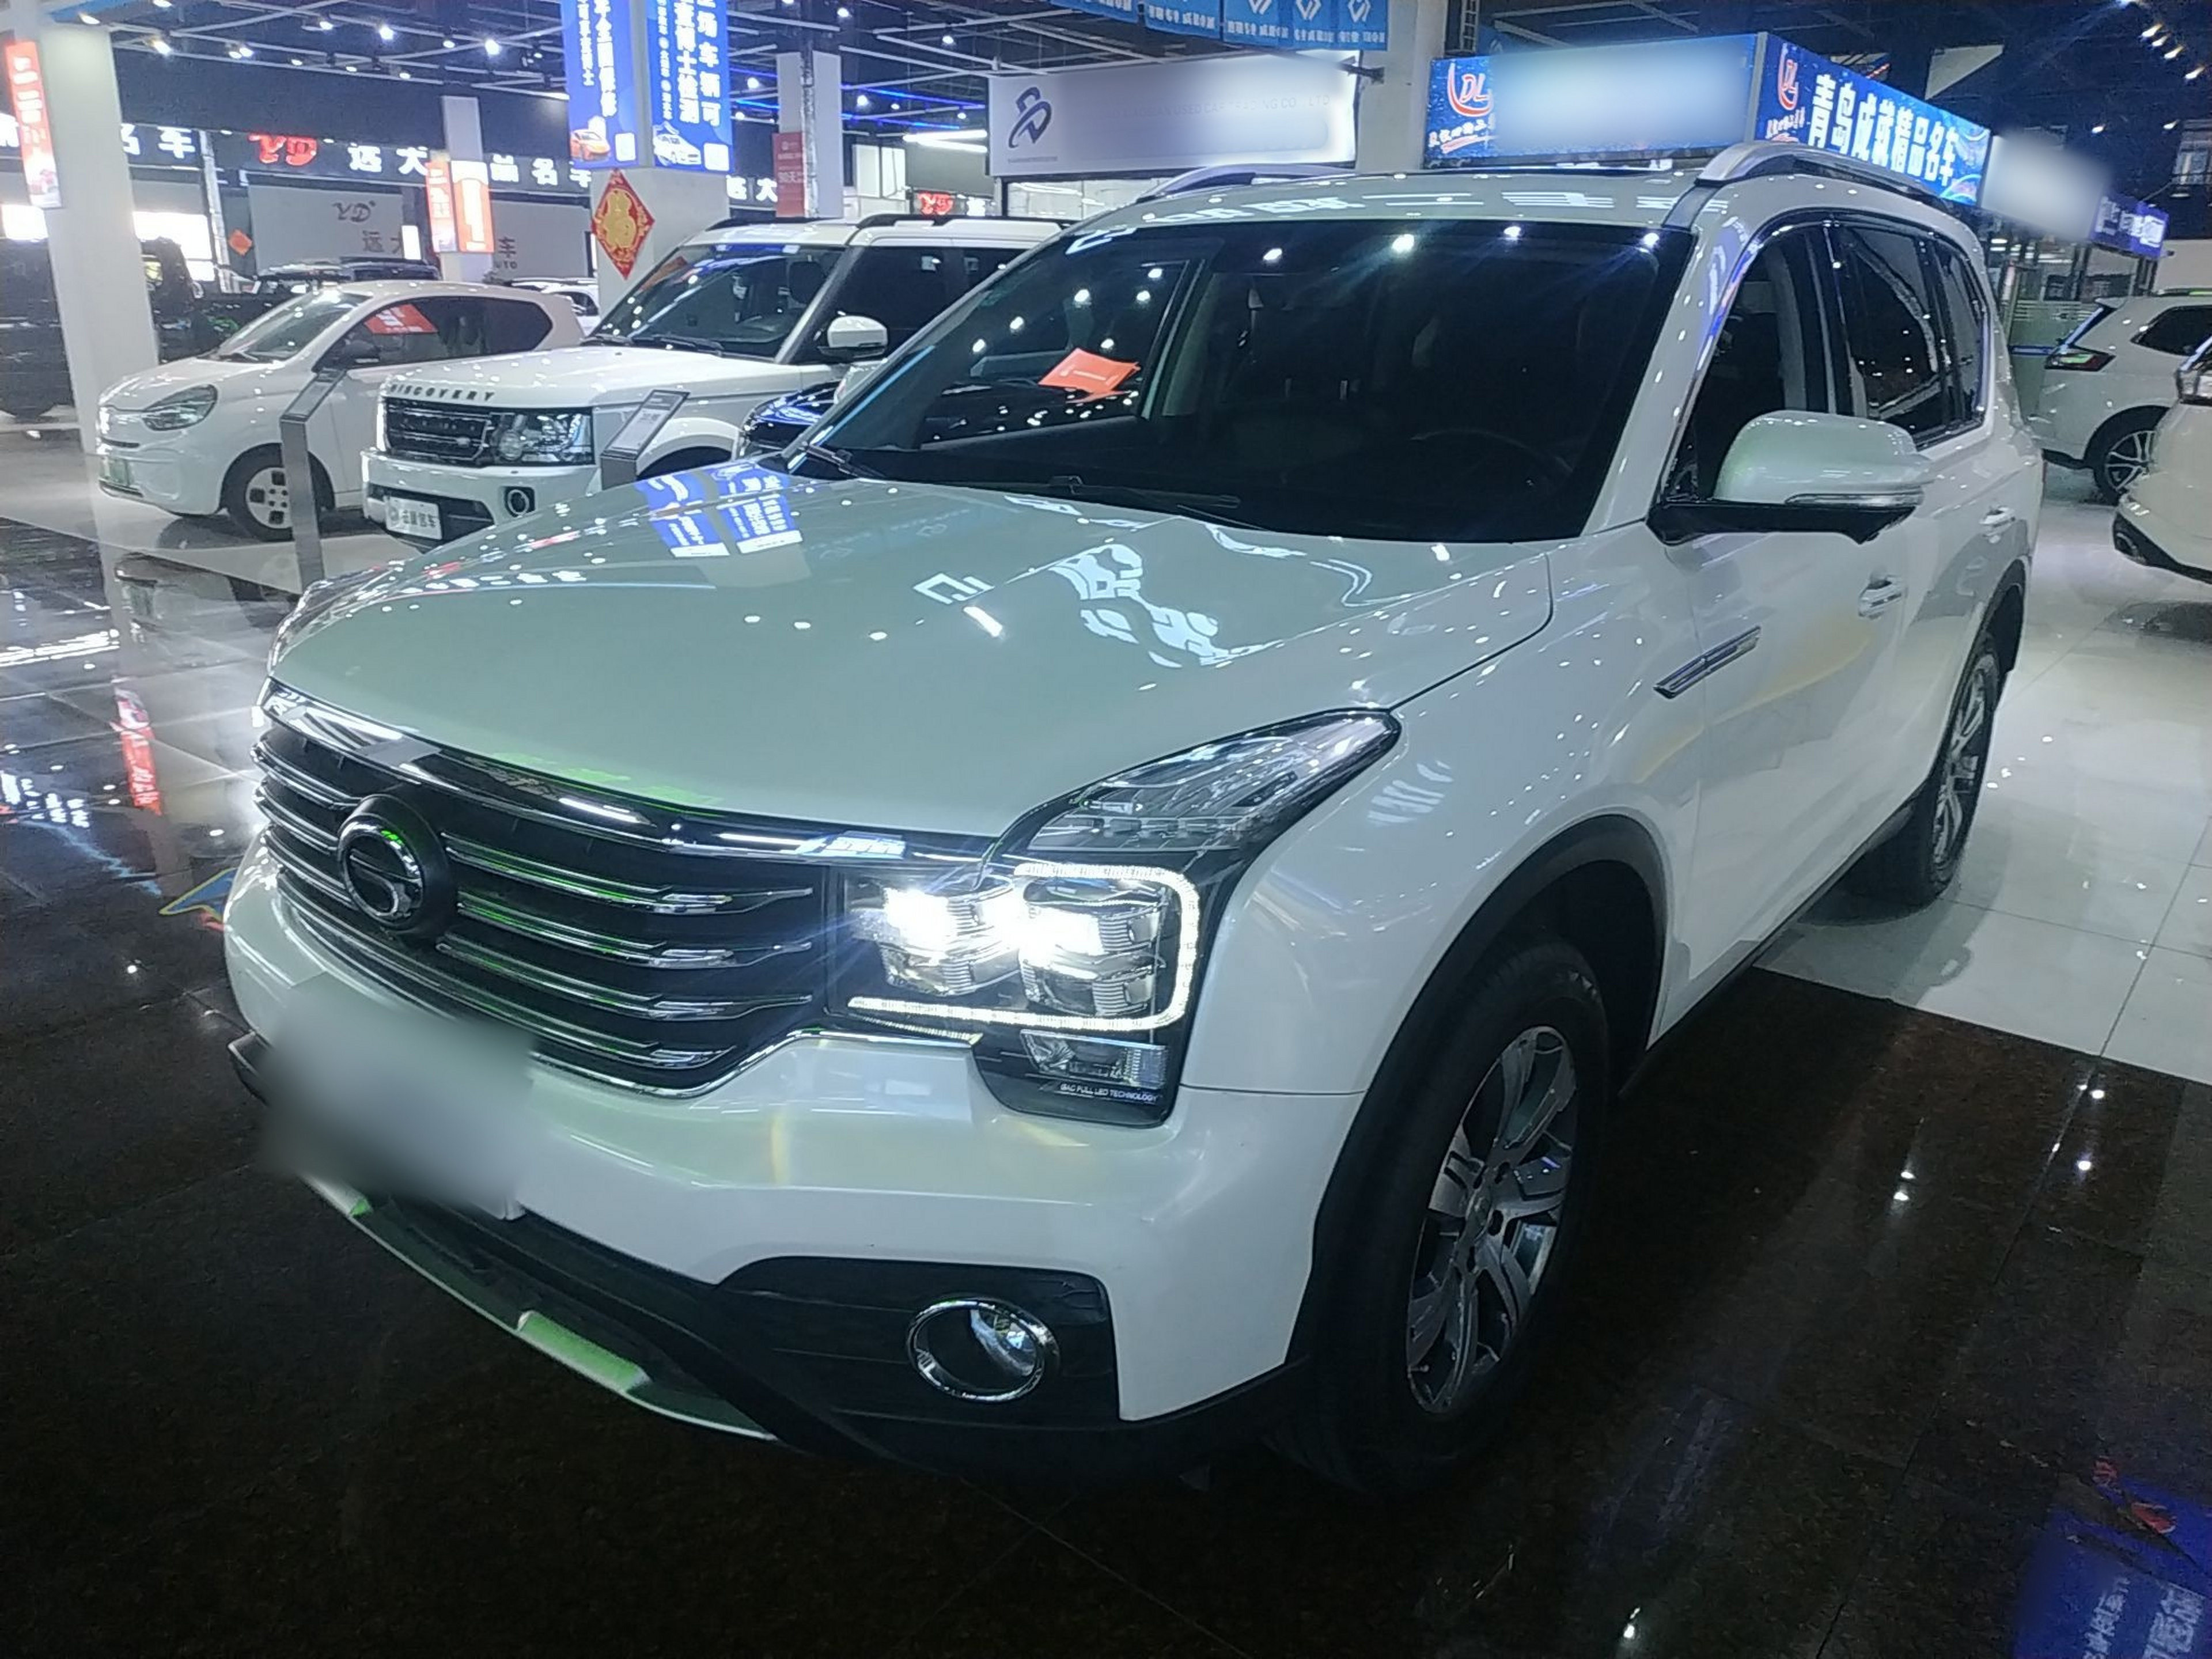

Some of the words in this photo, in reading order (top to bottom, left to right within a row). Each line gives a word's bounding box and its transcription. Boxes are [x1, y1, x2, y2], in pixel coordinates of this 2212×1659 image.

[390, 384, 495, 402] DISCOVERY
[1060, 1084, 1075, 1092] GAC
[1094, 1088, 1109, 1096] LED
[1109, 1089, 1157, 1102] TECHNOLOGY
